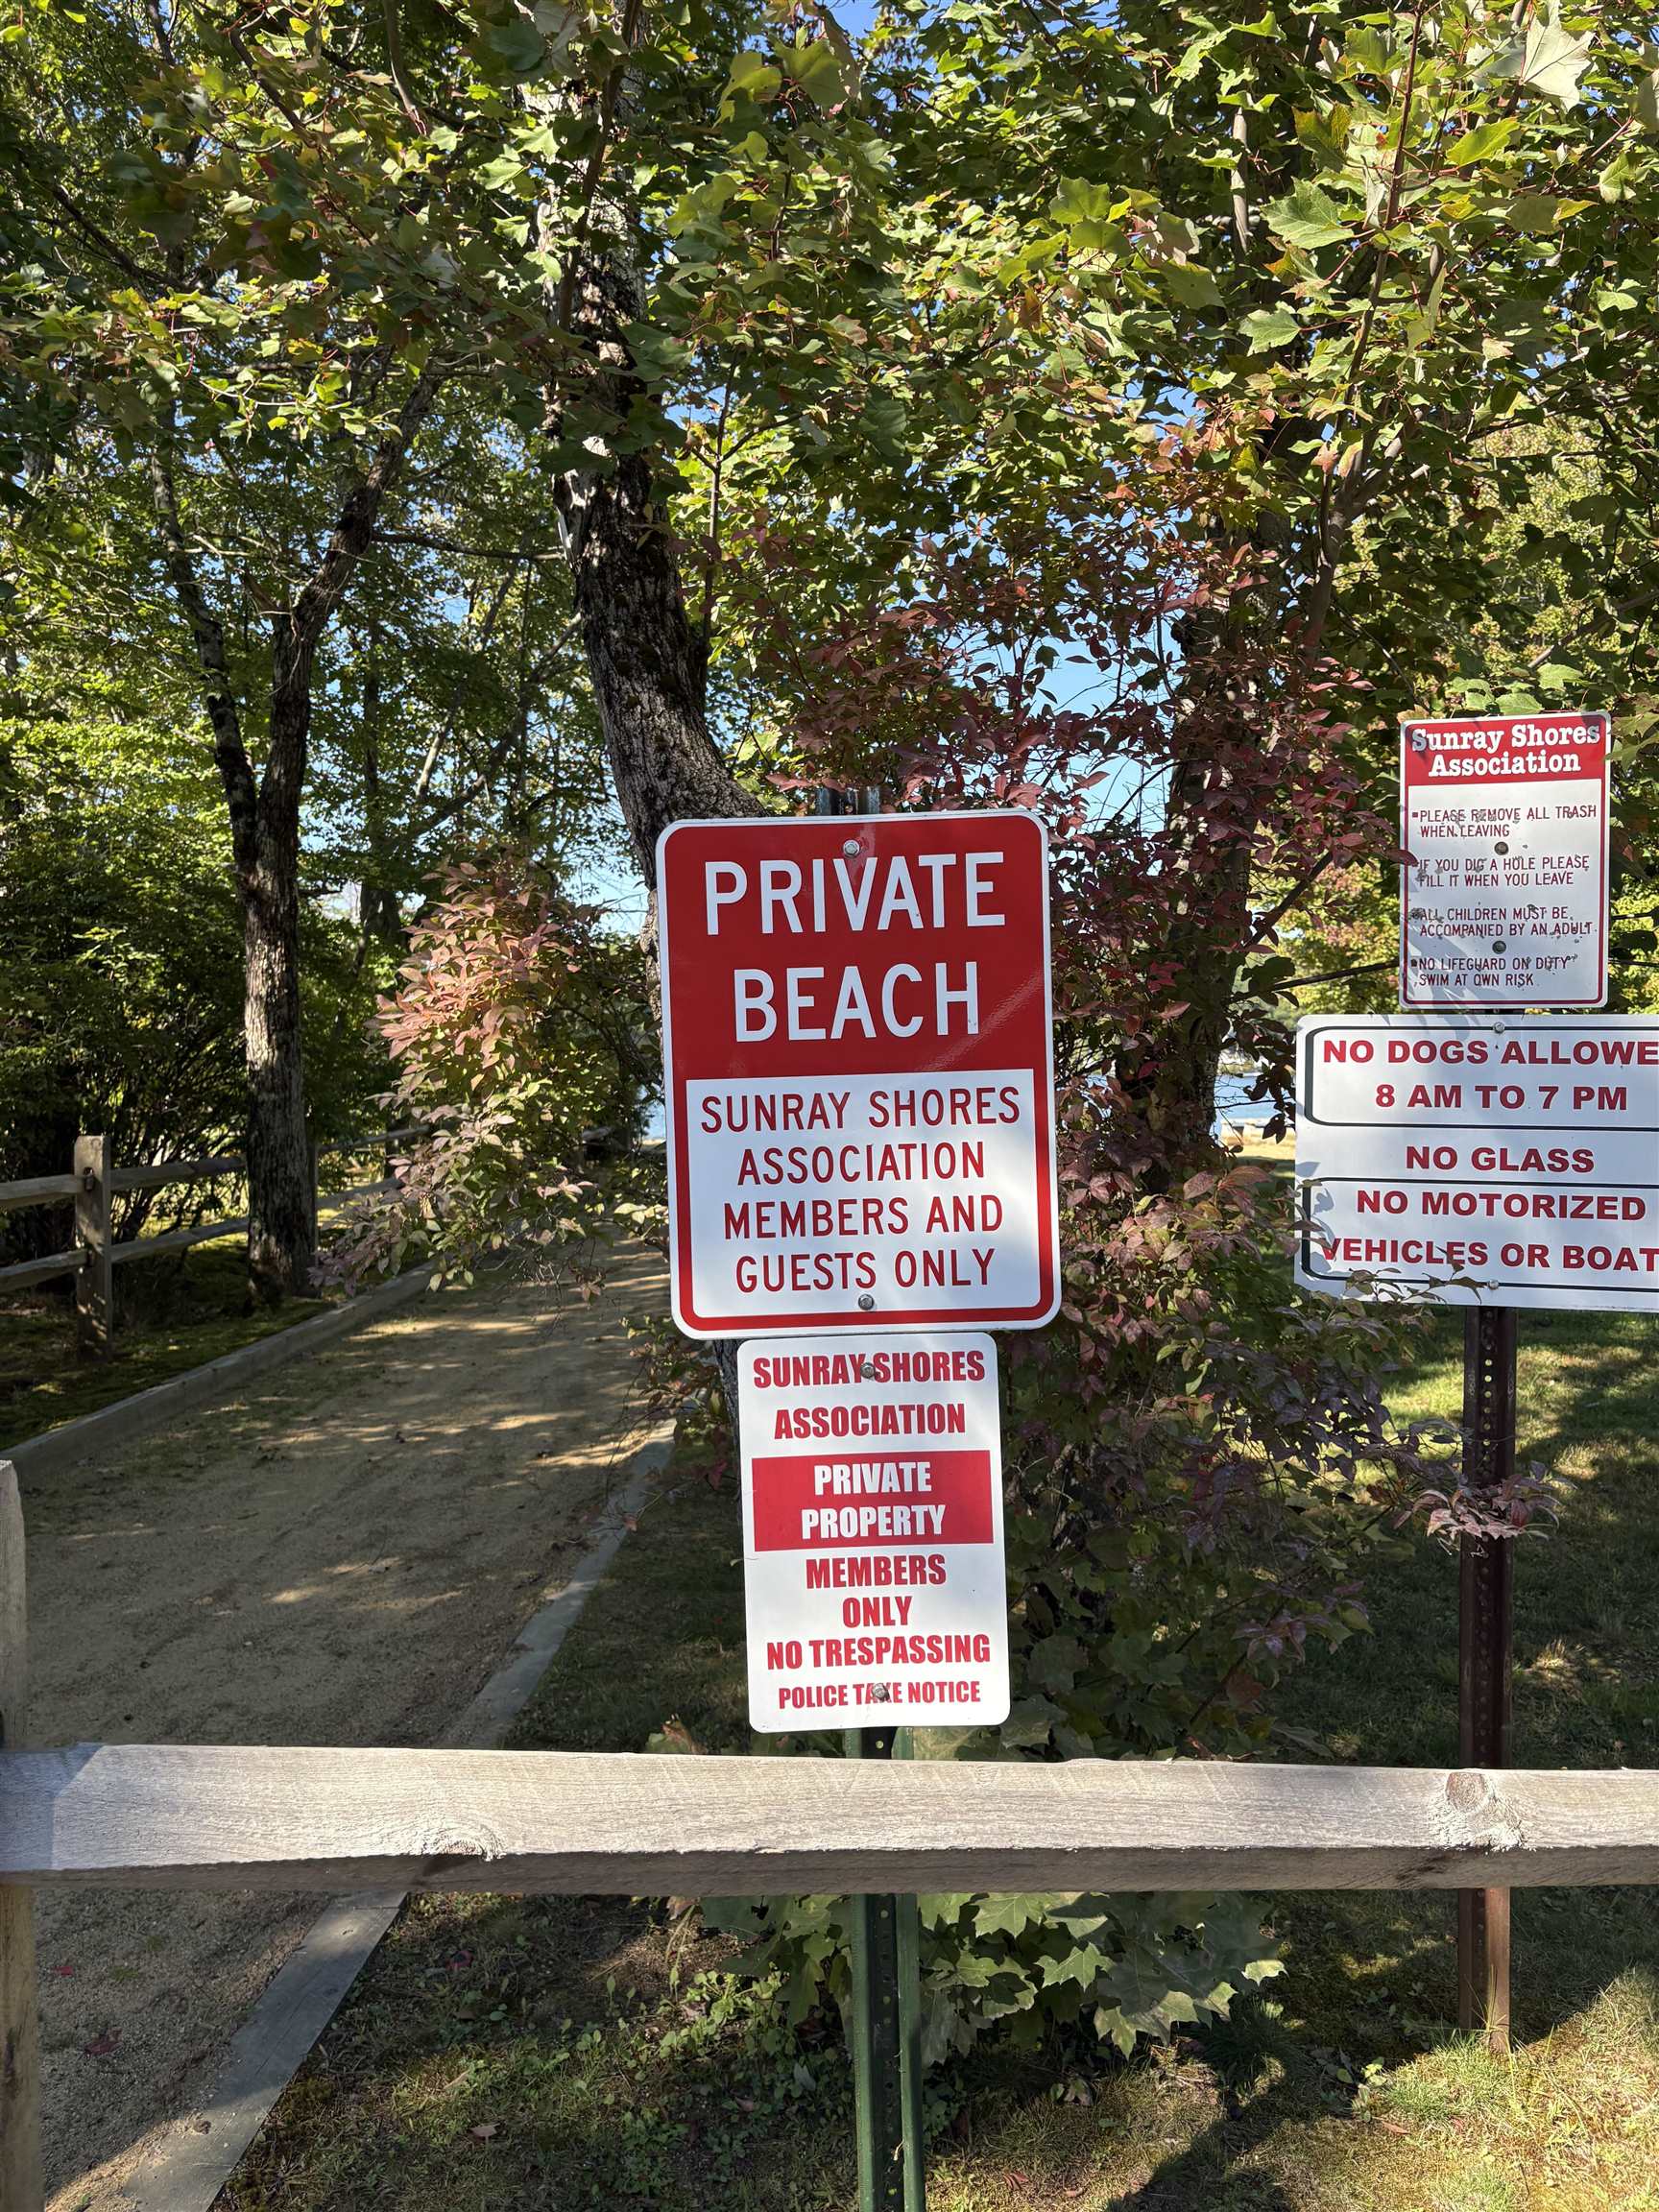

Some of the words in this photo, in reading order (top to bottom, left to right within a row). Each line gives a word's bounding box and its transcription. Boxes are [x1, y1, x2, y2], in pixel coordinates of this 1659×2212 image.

[1411, 729, 1504, 753] Sunray
[1512, 724, 1599, 748] Shores
[1429, 750, 1581, 777] Association
[1420, 809, 1465, 822] PLEASE
[1471, 808, 1521, 822] REMOVE
[1527, 807, 1550, 819] ALL
[1555, 805, 1596, 818] TRASH
[1421, 826, 1455, 837] WHEN
[1461, 825, 1510, 837] LEAVING
[1420, 859, 1430, 871] IF
[1435, 859, 1458, 871] YOU
[1466, 858, 1484, 871] DIG
[1490, 858, 1498, 870] A
[1503, 857, 1535, 870] HOLE
[1543, 856, 1589, 869] PLEASE
[705, 852, 1005, 936] PRIVATE
[1419, 875, 1443, 887] FILL
[1450, 875, 1459, 886] IT
[1465, 874, 1499, 886] WHEN
[1505, 874, 1528, 885] YOU
[1536, 873, 1574, 884] LEAVE
[1420, 909, 1438, 921] ALL
[1447, 908, 1506, 921] CHILDREN
[1513, 907, 1547, 920] MUST
[1552, 907, 1568, 919] BE
[1420, 925, 1503, 936] ACCOMPANIED
[1509, 924, 1526, 936] BY
[1531, 924, 1548, 935] AN
[1554, 922, 1593, 934] ADULT
[1419, 958, 1434, 970] NO
[1441, 958, 1506, 971] LIFEGUARD
[1513, 958, 1529, 970] ON
[1537, 957, 1568, 970] DUTY
[1419, 974, 1449, 986] SWIM
[1455, 974, 1469, 985] AT
[1474, 974, 1499, 985] OWN
[1505, 974, 1534, 985] RISK
[733, 962, 978, 1042] BEACH
[1323, 1040, 1375, 1064] NO
[1388, 1041, 1488, 1064] DOGS
[1501, 1041, 1659, 1065] ALLOWE
[701, 1092, 851, 1134] SUNRAY
[868, 1086, 1020, 1128] SHORES
[1376, 1084, 1395, 1108] 8
[1407, 1085, 1461, 1108] AM
[1475, 1085, 1525, 1109] TO
[1538, 1086, 1558, 1109] 7
[1574, 1087, 1626, 1111] PM
[737, 1142, 984, 1186] ASSOCIATION
[1407, 1146, 1457, 1169] NO
[1471, 1147, 1594, 1173] GLASS
[724, 1196, 908, 1239] MEMBERS
[926, 1194, 1002, 1235] AND
[1357, 1190, 1408, 1214] NO
[1422, 1191, 1646, 1220] MOTORIZED
[1321, 1238, 1488, 1265] VEHICLES
[1501, 1243, 1551, 1267] OR
[1563, 1247, 1659, 1272] BOAT
[735, 1252, 876, 1293] GUESTS
[895, 1249, 995, 1287] ONLY
[754, 1354, 865, 1388] SUNRAY
[874, 1350, 985, 1382] SHORES
[774, 1403, 966, 1439] ASSOCIATION
[814, 1462, 931, 1496] PRIVATE
[802, 1505, 945, 1539] PROPERTY
[805, 1554, 946, 1589] MEMBERS
[843, 1596, 911, 1628] ONLY
[768, 1641, 803, 1670] NO
[808, 1634, 990, 1668] TRESPASSING
[779, 1685, 848, 1709] POLICE
[908, 1681, 980, 1704] NOTICE
